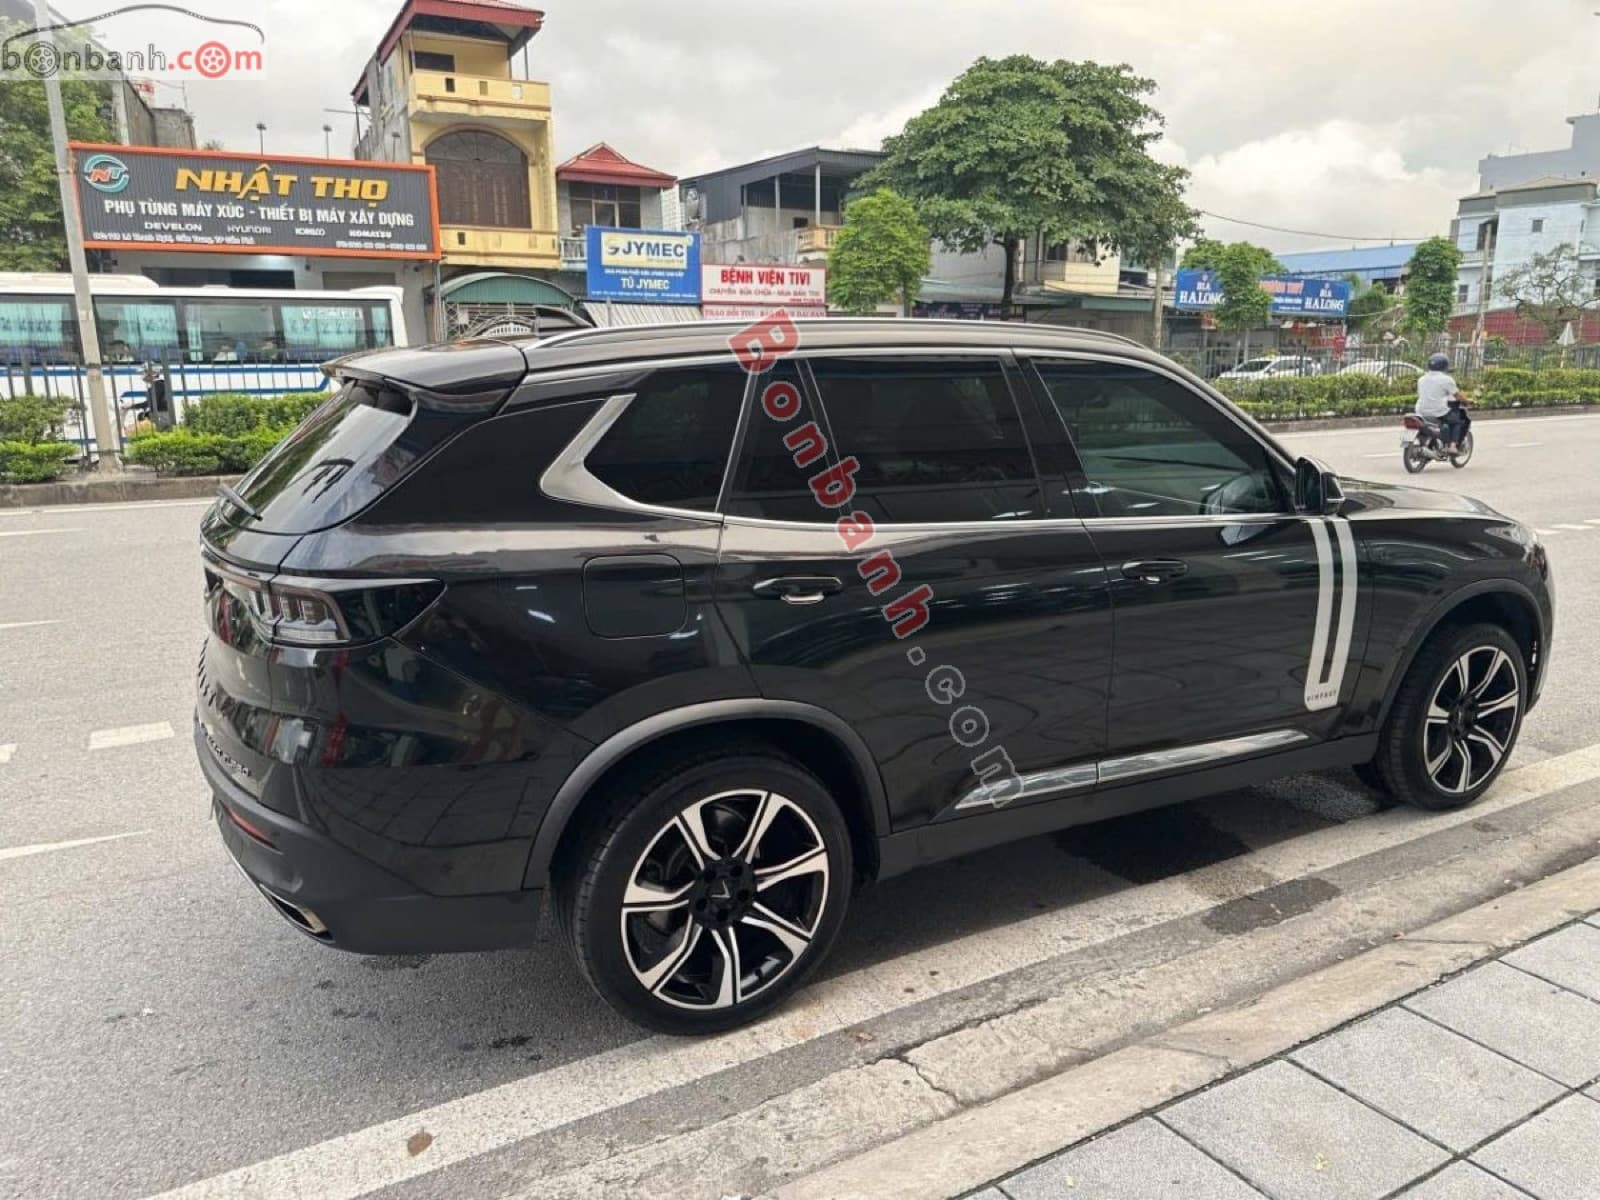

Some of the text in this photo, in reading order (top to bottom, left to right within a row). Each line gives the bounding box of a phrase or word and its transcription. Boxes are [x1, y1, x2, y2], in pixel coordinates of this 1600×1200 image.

[175, 163, 388, 208] NHẬT THỌ
[104, 199, 136, 218] PHỤ
[139, 198, 178, 216] TÙNG
[182, 200, 212, 217] MÁY
[217, 201, 245, 218] XÚC
[259, 203, 295, 221] THIẾT
[300, 208, 314, 225] BỊ
[317, 206, 346, 224] MÁY
[350, 208, 376, 225] XÂY
[144, 221, 202, 232] DEVELON
[622, 240, 685, 258] JYMEC
[636, 278, 670, 291] JYMEC
[720, 268, 811, 287] BỆNH VIỆN TIVI
